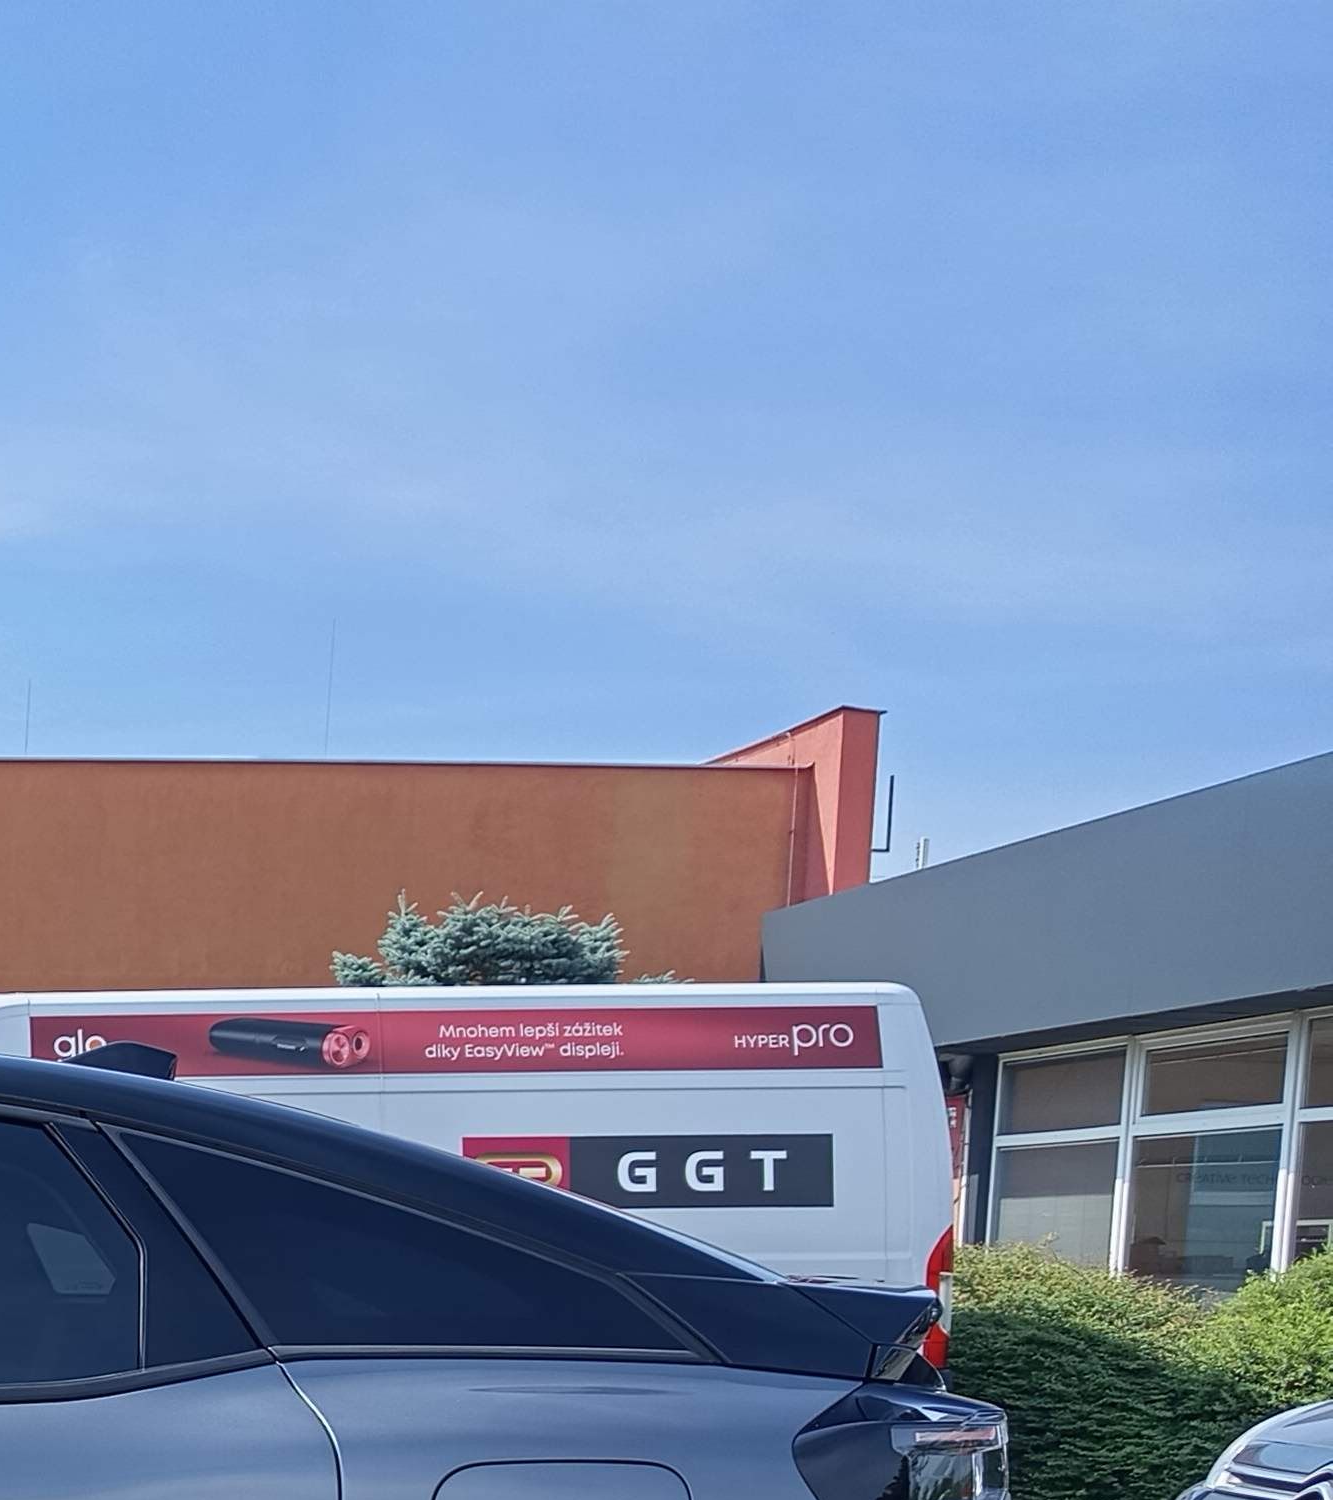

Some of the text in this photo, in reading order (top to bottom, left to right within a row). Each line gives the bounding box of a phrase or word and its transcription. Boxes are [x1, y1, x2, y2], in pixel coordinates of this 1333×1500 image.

[438, 1021, 624, 1040] Mnohem lepší zážitek
[733, 1023, 855, 1057] HYPER pro
[559, 1041, 625, 1060] displeji.
